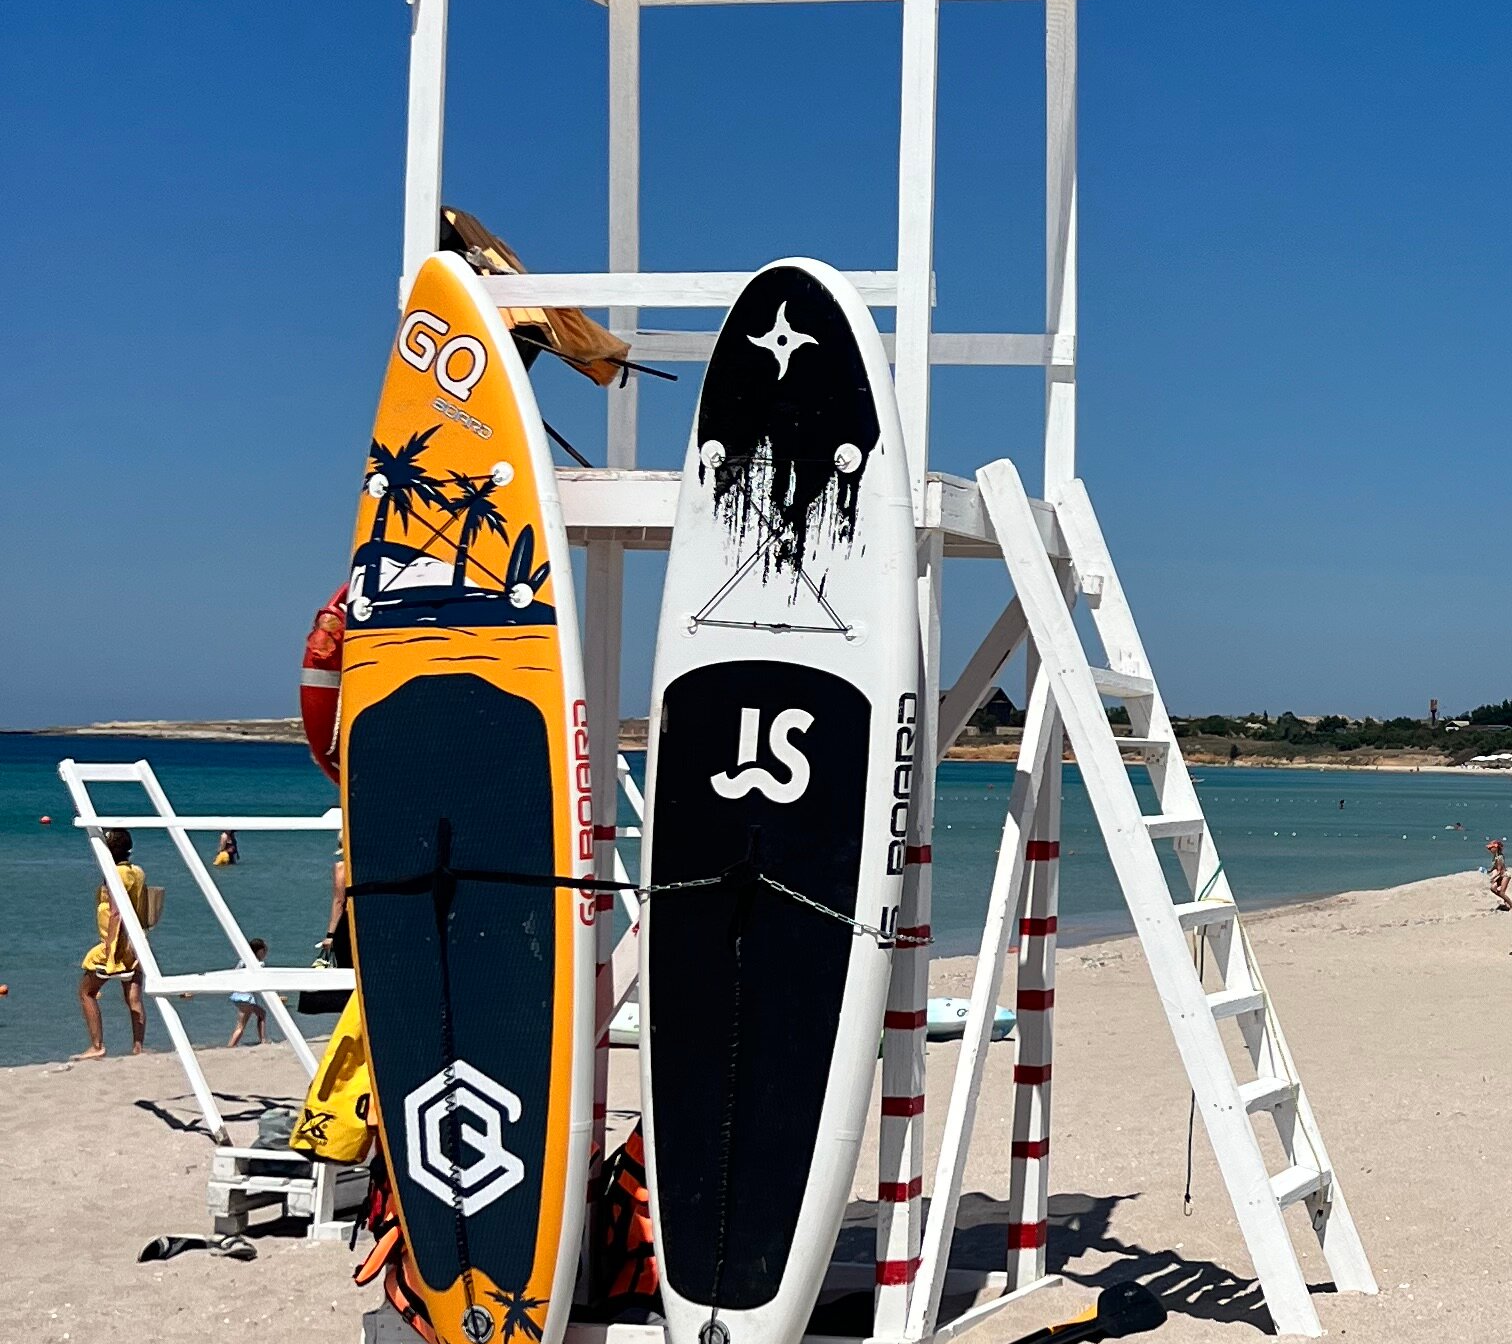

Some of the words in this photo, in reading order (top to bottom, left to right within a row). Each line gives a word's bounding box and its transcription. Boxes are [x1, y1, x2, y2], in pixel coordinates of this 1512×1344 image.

[398, 309, 488, 402] GQ
[432, 396, 493, 440] BOARD
[573, 699, 593, 860] BOARD
[711, 707, 815, 803] JS
[886, 692, 917, 875] BOARD
